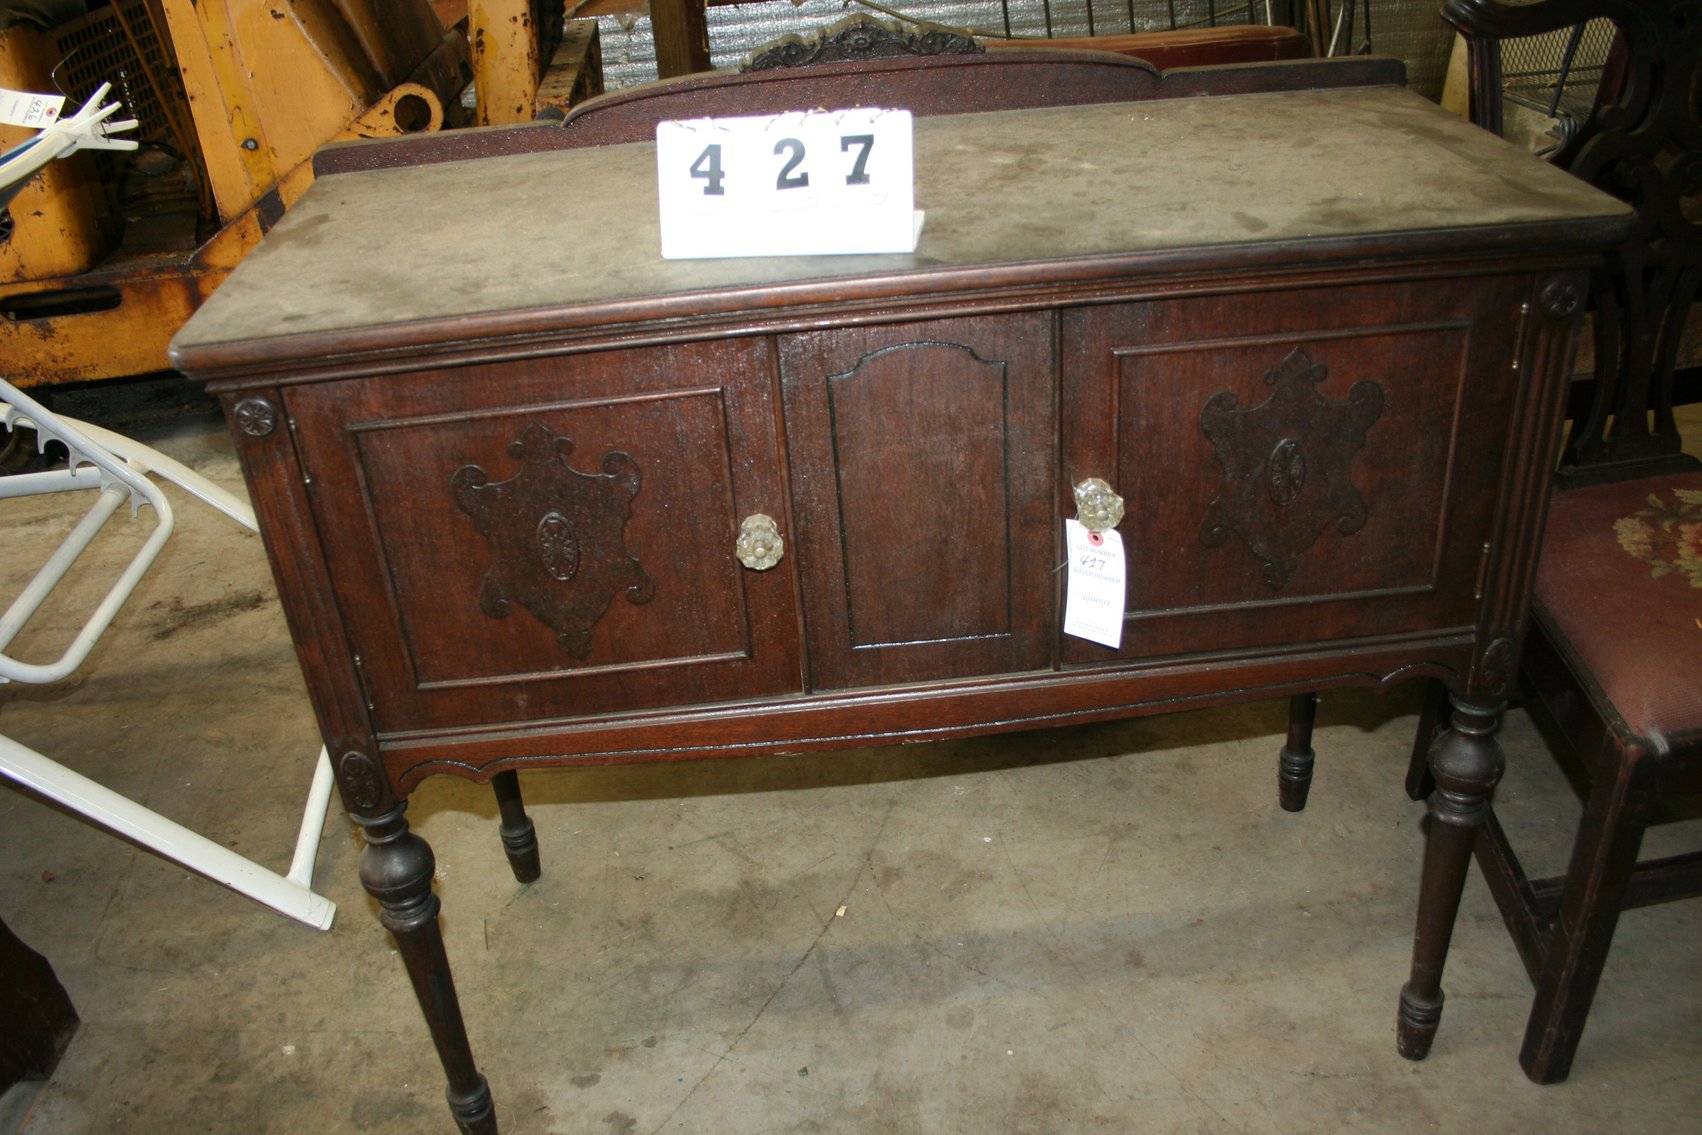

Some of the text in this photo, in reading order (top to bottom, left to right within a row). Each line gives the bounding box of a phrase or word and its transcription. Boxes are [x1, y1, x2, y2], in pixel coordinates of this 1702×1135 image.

[1076, 544, 1116, 559] LOT NUMBER
[1079, 554, 1106, 572] 427
[1073, 566, 1121, 584] BUYER NUMBER
[1081, 593, 1111, 606] QUANTITY
